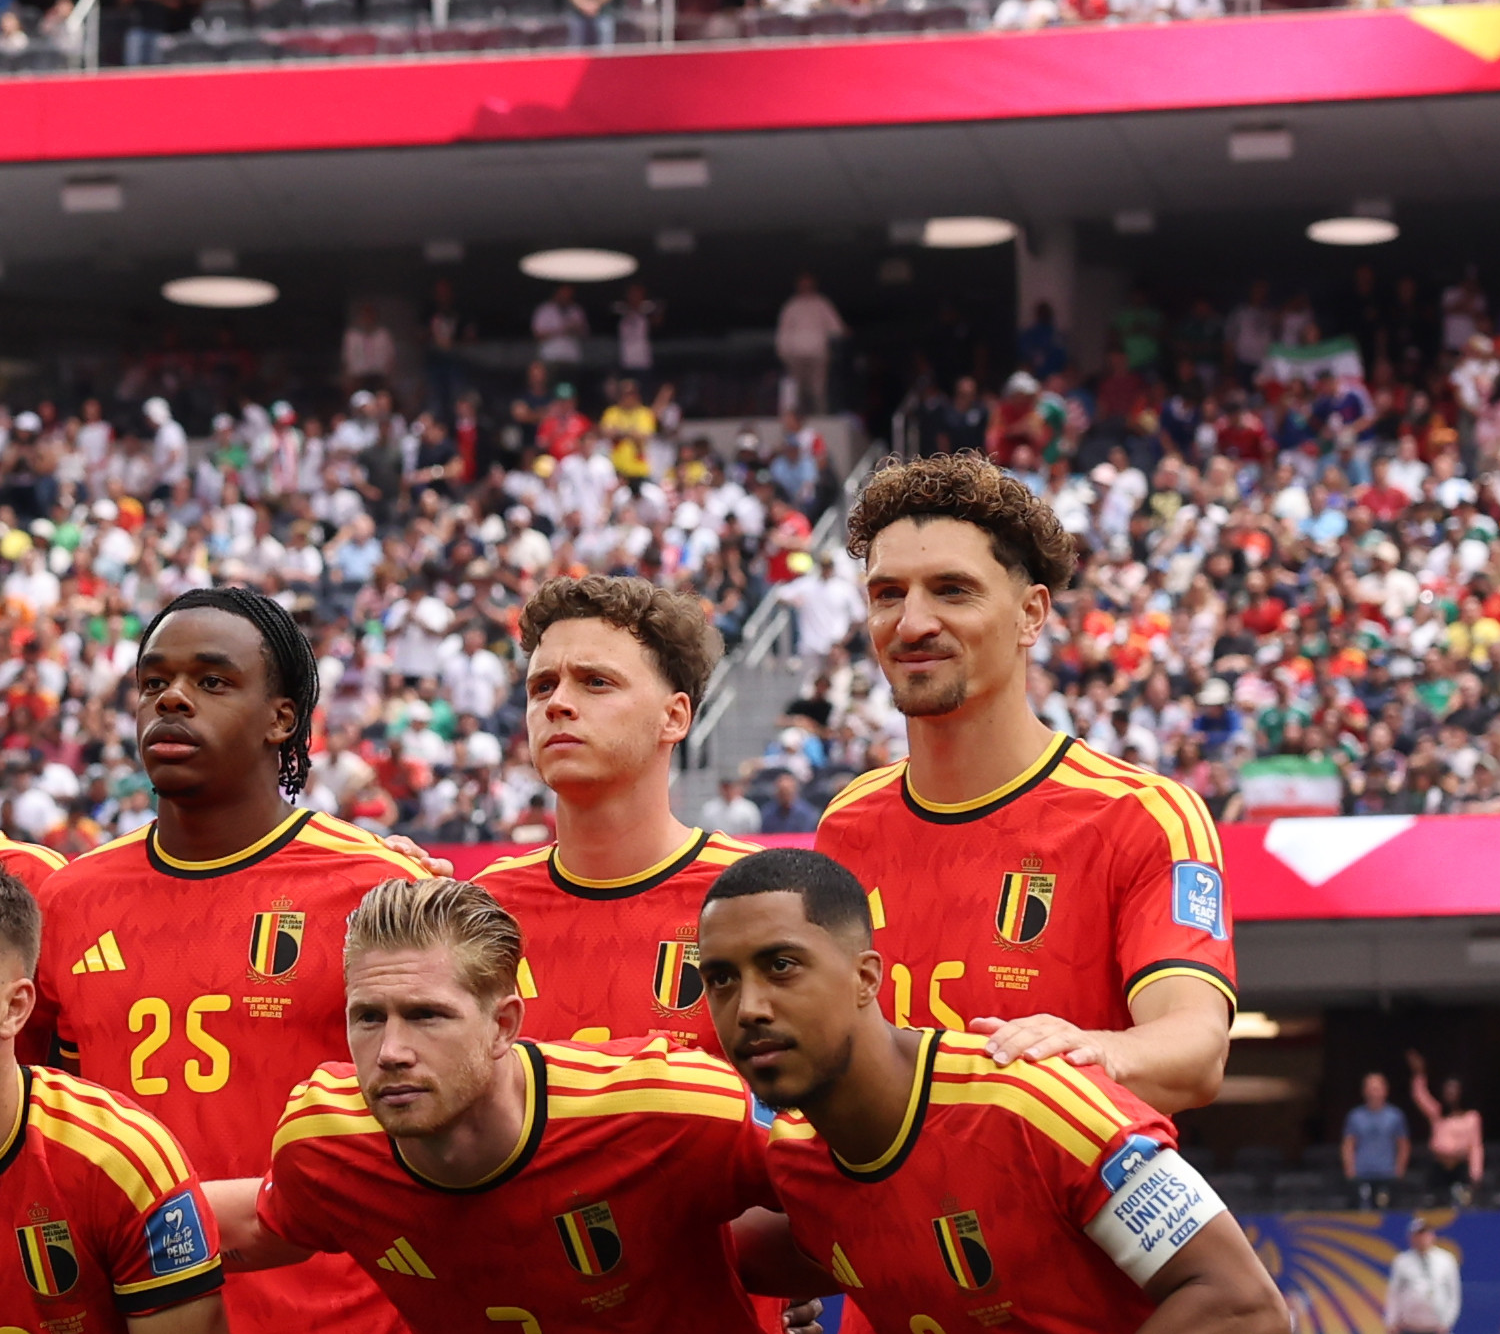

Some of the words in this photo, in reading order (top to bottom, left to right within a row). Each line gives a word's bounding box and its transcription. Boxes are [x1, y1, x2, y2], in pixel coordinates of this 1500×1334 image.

[128, 994, 232, 1096] 25
[1113, 1168, 1172, 1221] FOOTBALL
[1125, 1177, 1187, 1235] UNITES
[1139, 1227, 1165, 1252] the
[1161, 1187, 1204, 1229] World
[166, 1238, 195, 1259] PEACE
[1169, 1218, 1199, 1247] FIFA
